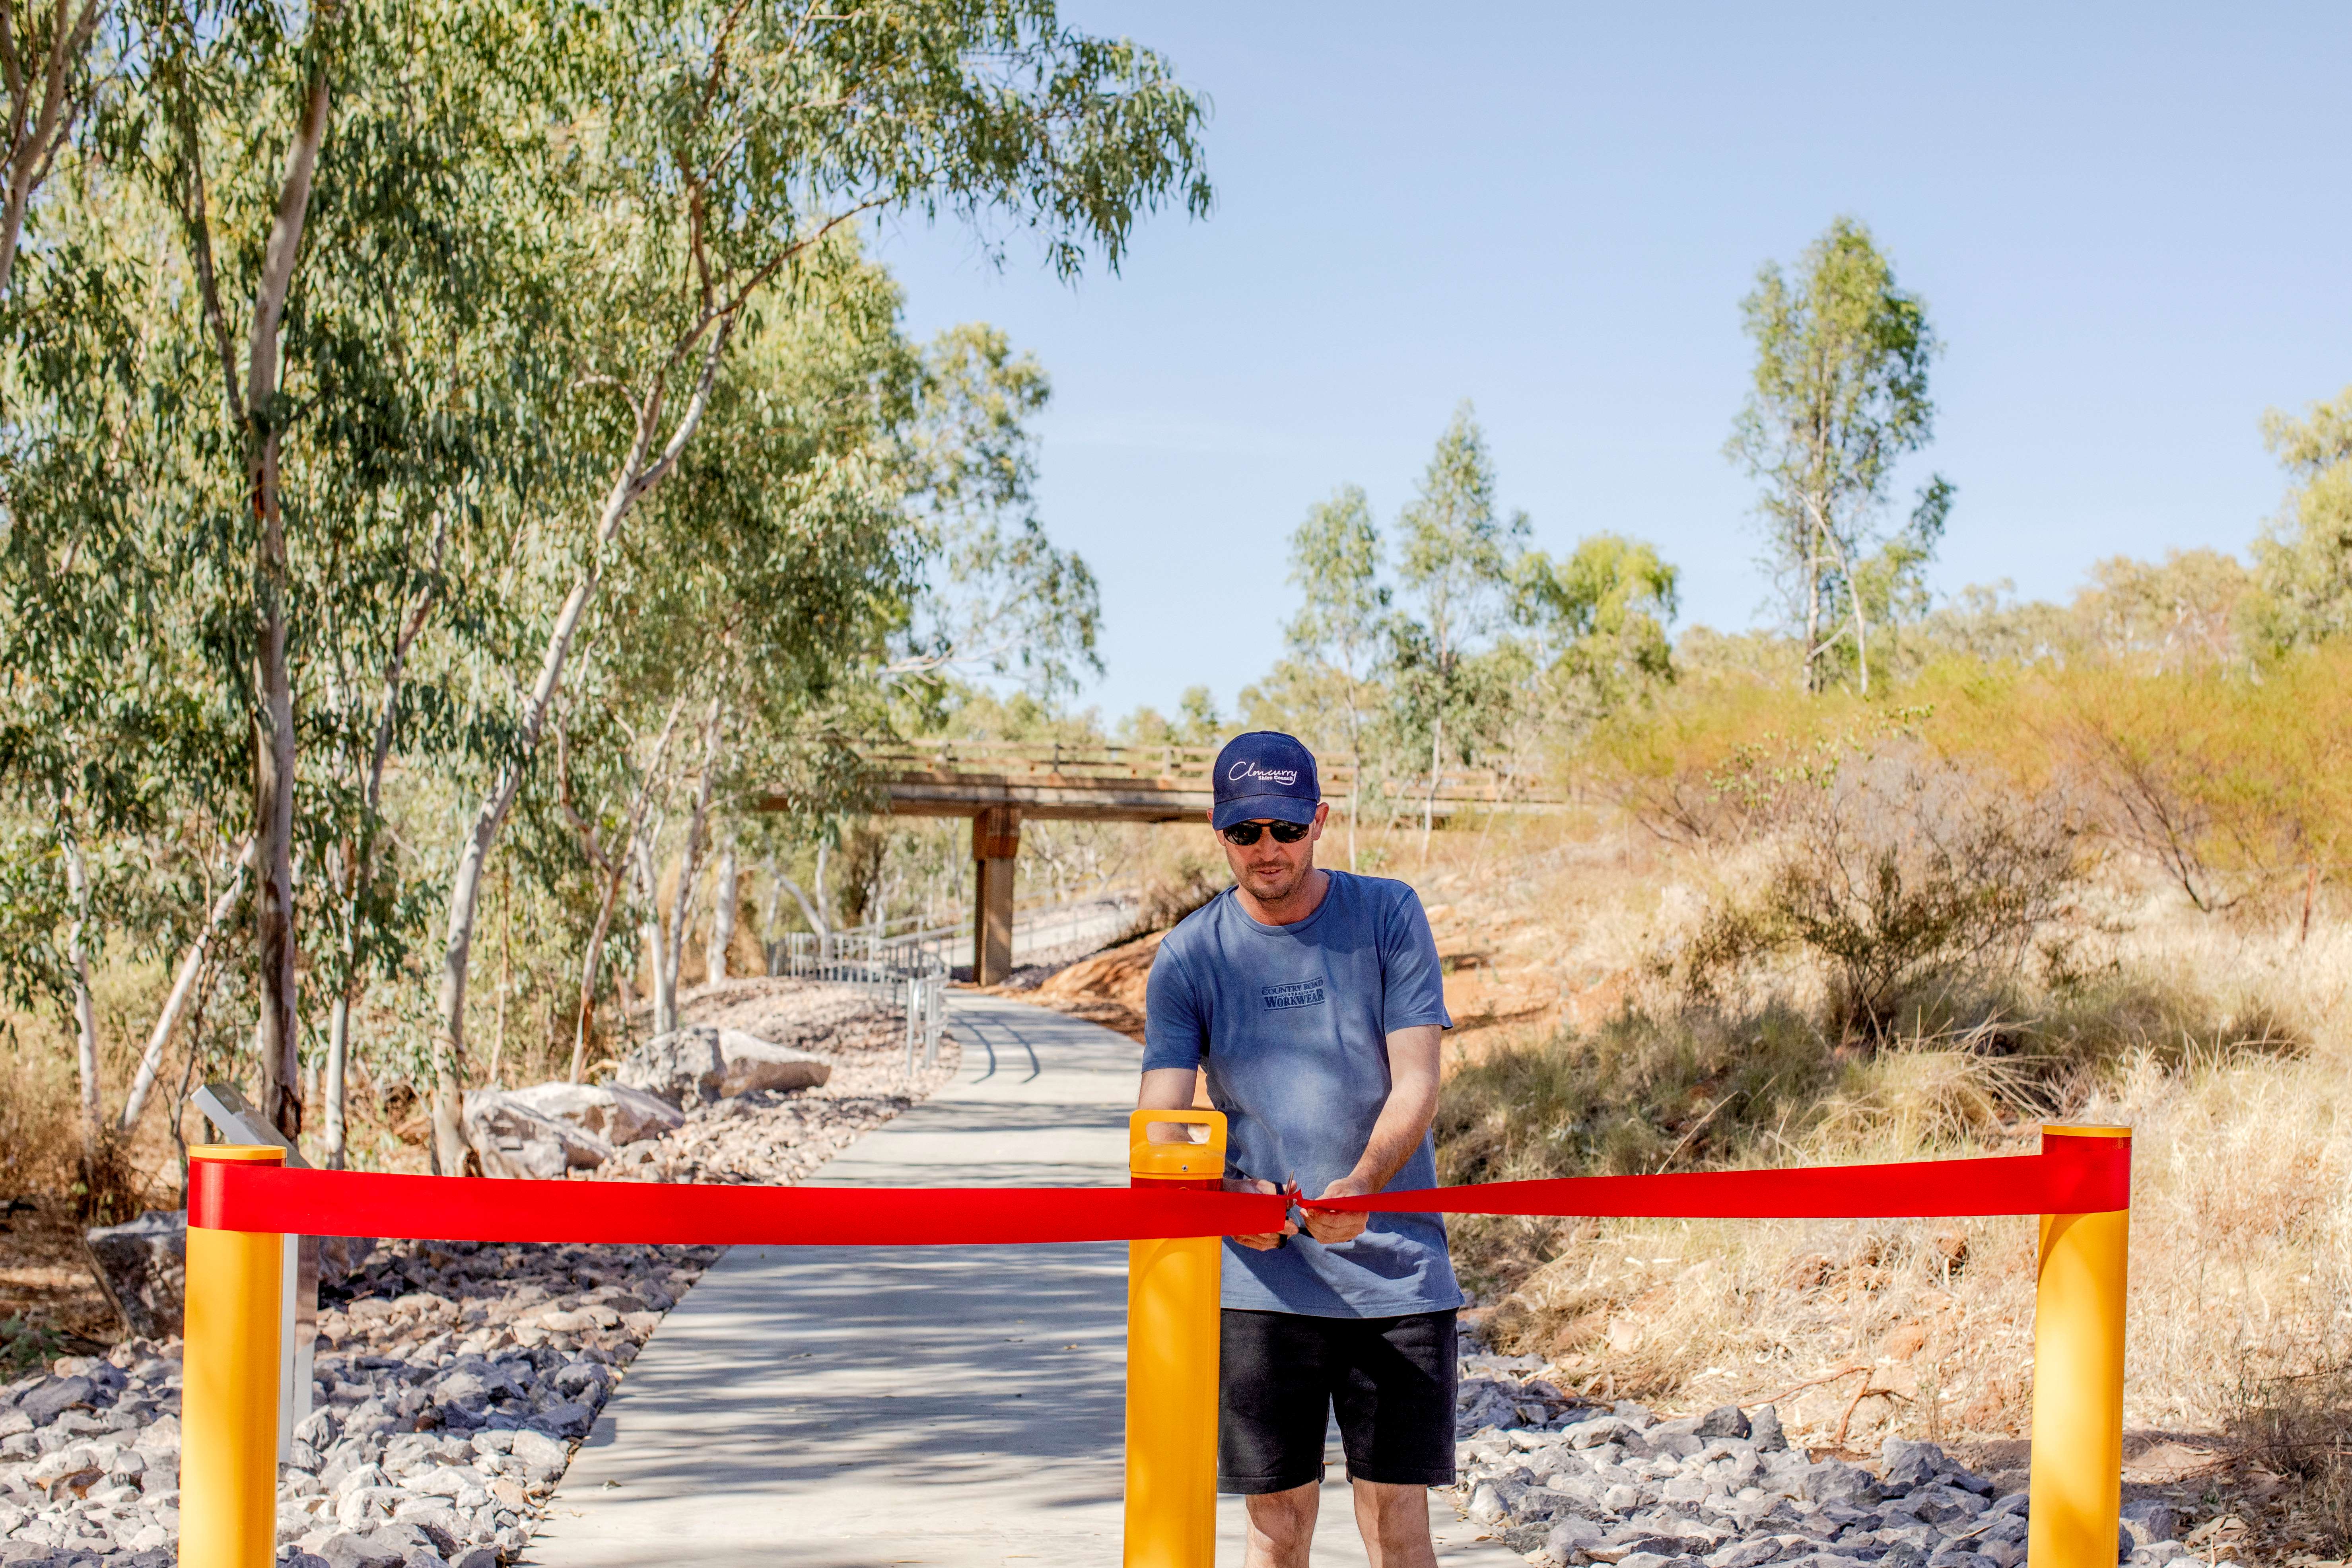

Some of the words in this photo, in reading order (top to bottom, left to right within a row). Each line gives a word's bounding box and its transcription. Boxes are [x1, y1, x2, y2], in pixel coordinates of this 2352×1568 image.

[1229, 762, 1297, 785] Cloncurry
[1262, 984, 1302, 995] COUNTRY
[1303, 979, 1324, 989] ROAD
